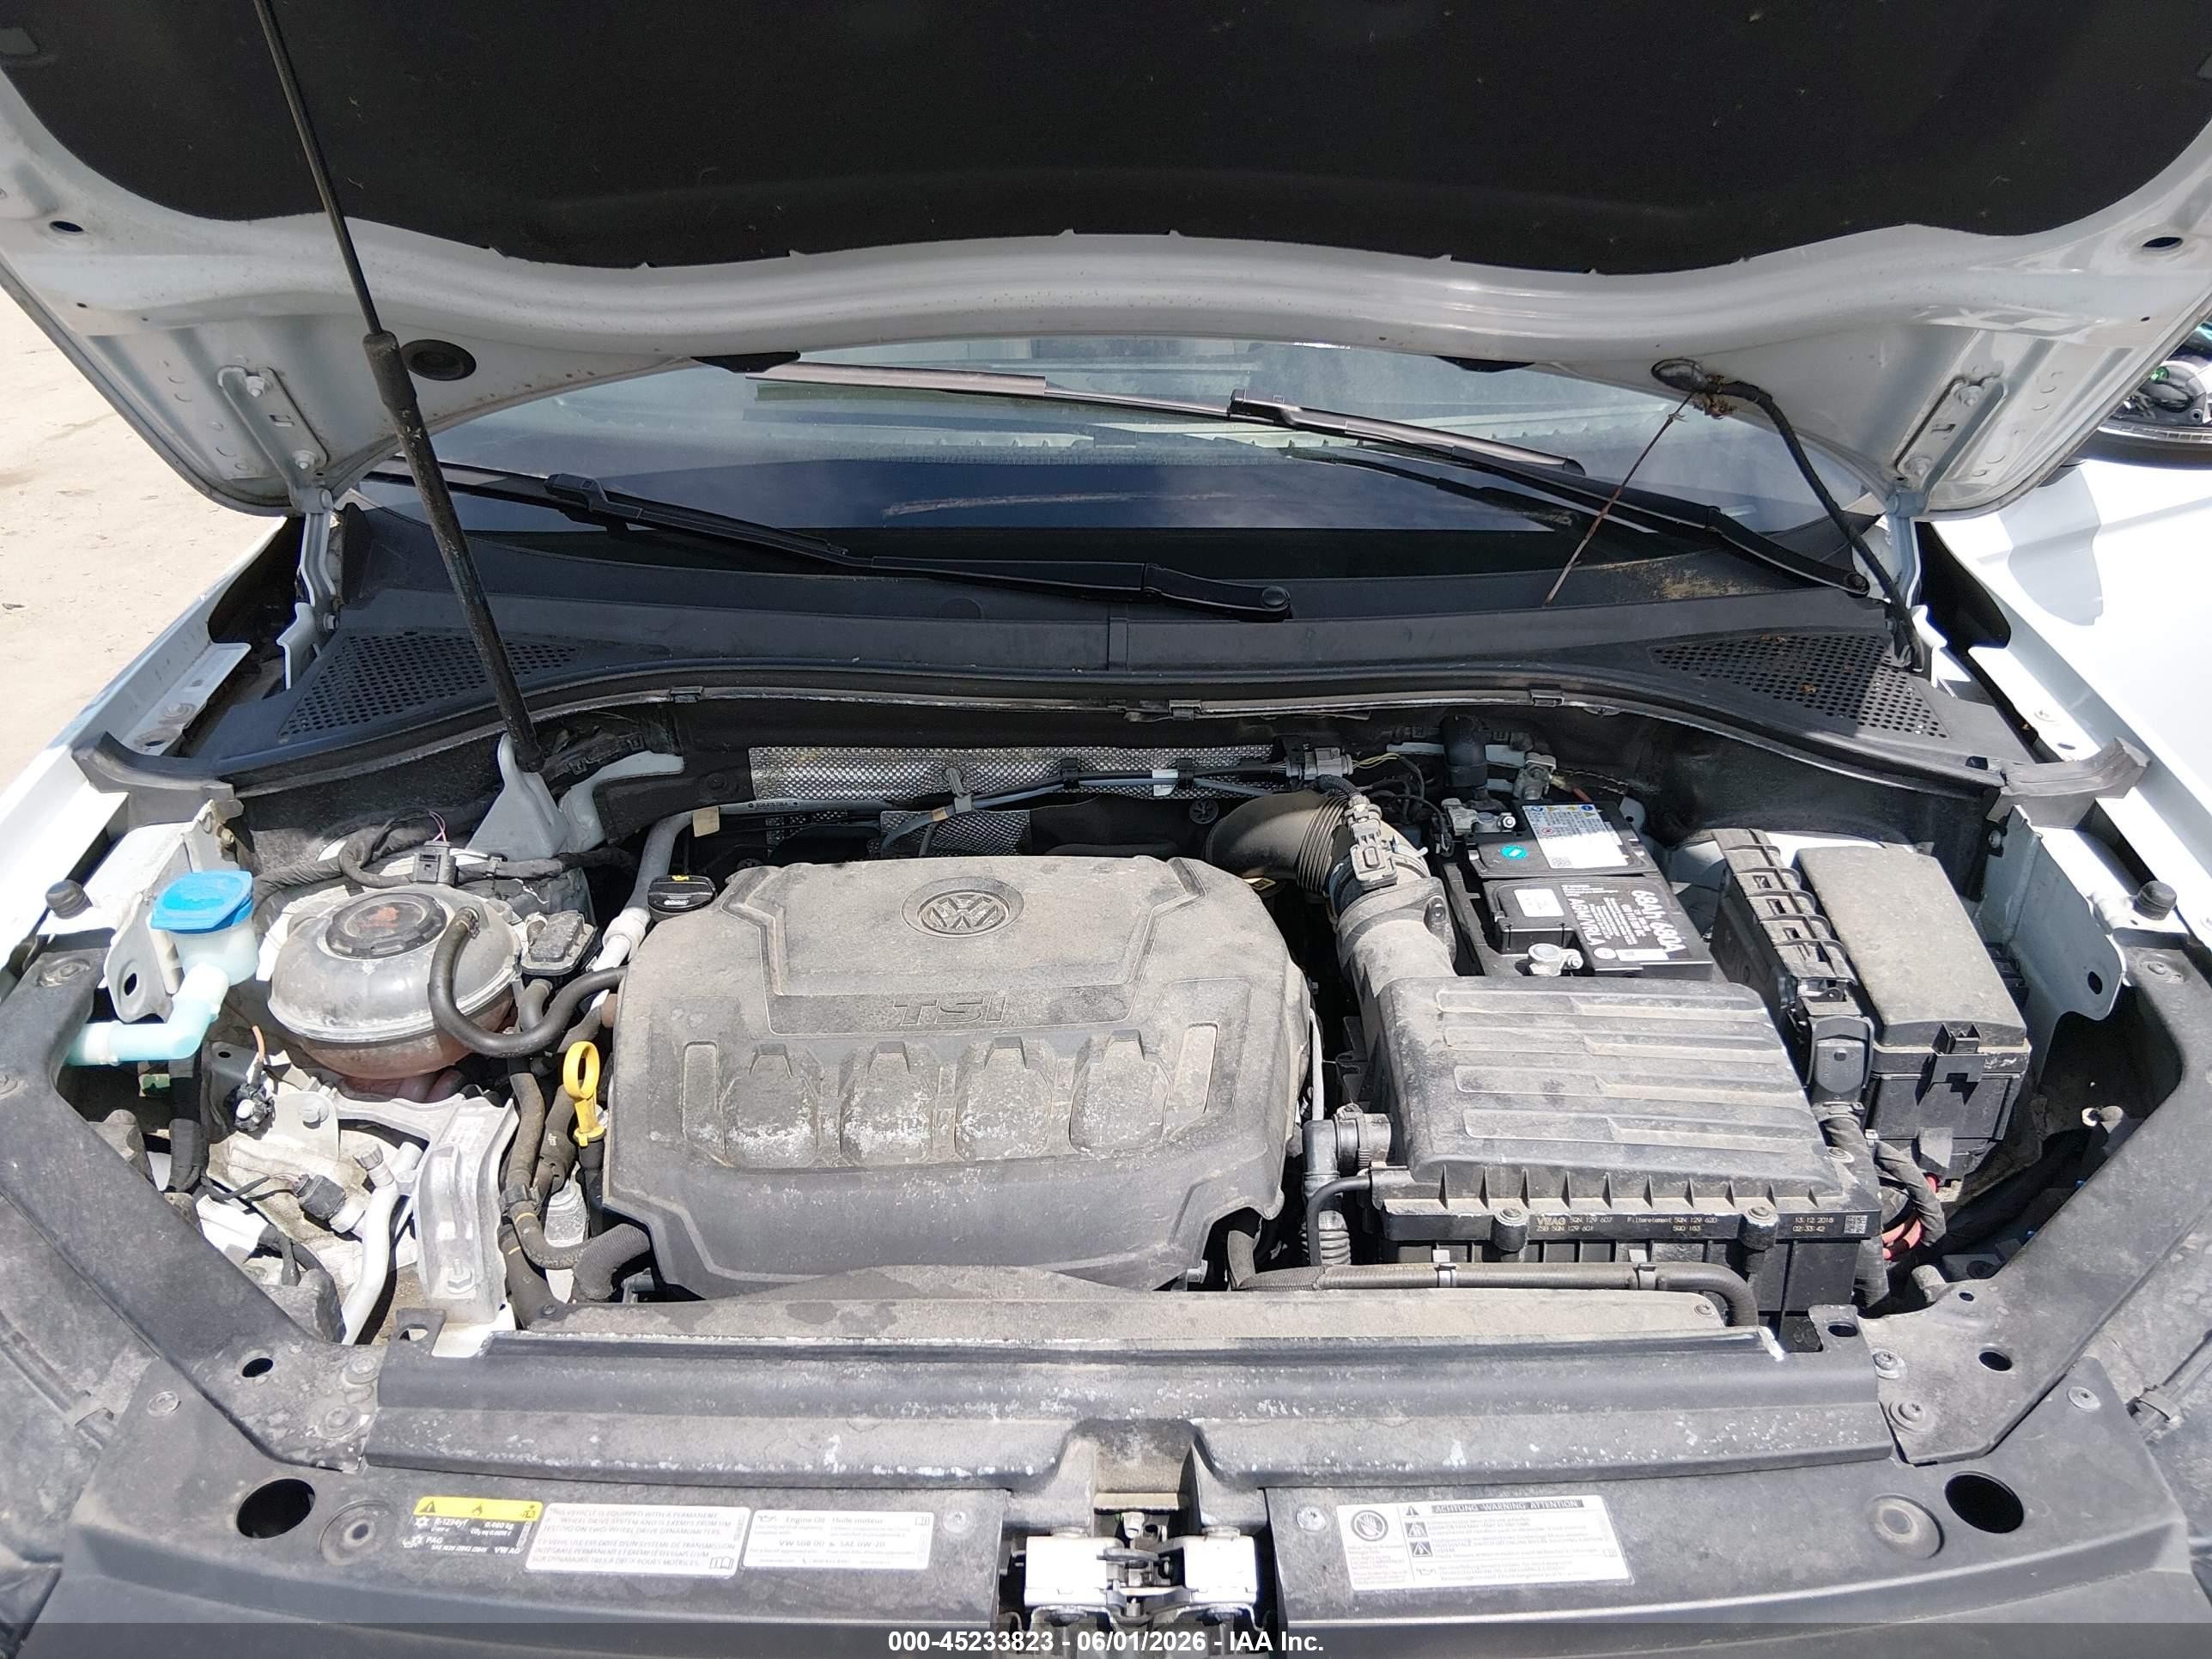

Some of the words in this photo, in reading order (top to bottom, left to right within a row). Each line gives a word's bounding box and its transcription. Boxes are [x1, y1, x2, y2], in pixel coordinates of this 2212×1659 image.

[1567, 897, 1606, 946] AGM/VRLA
[893, 996, 1007, 1026] TSI
[1435, 1504, 1479, 1513] ACHTUNG
[1482, 1502, 1525, 1511] WARNING
[1530, 1500, 1578, 1510] ATTENTION
[785, 1516, 812, 1525] Engine
